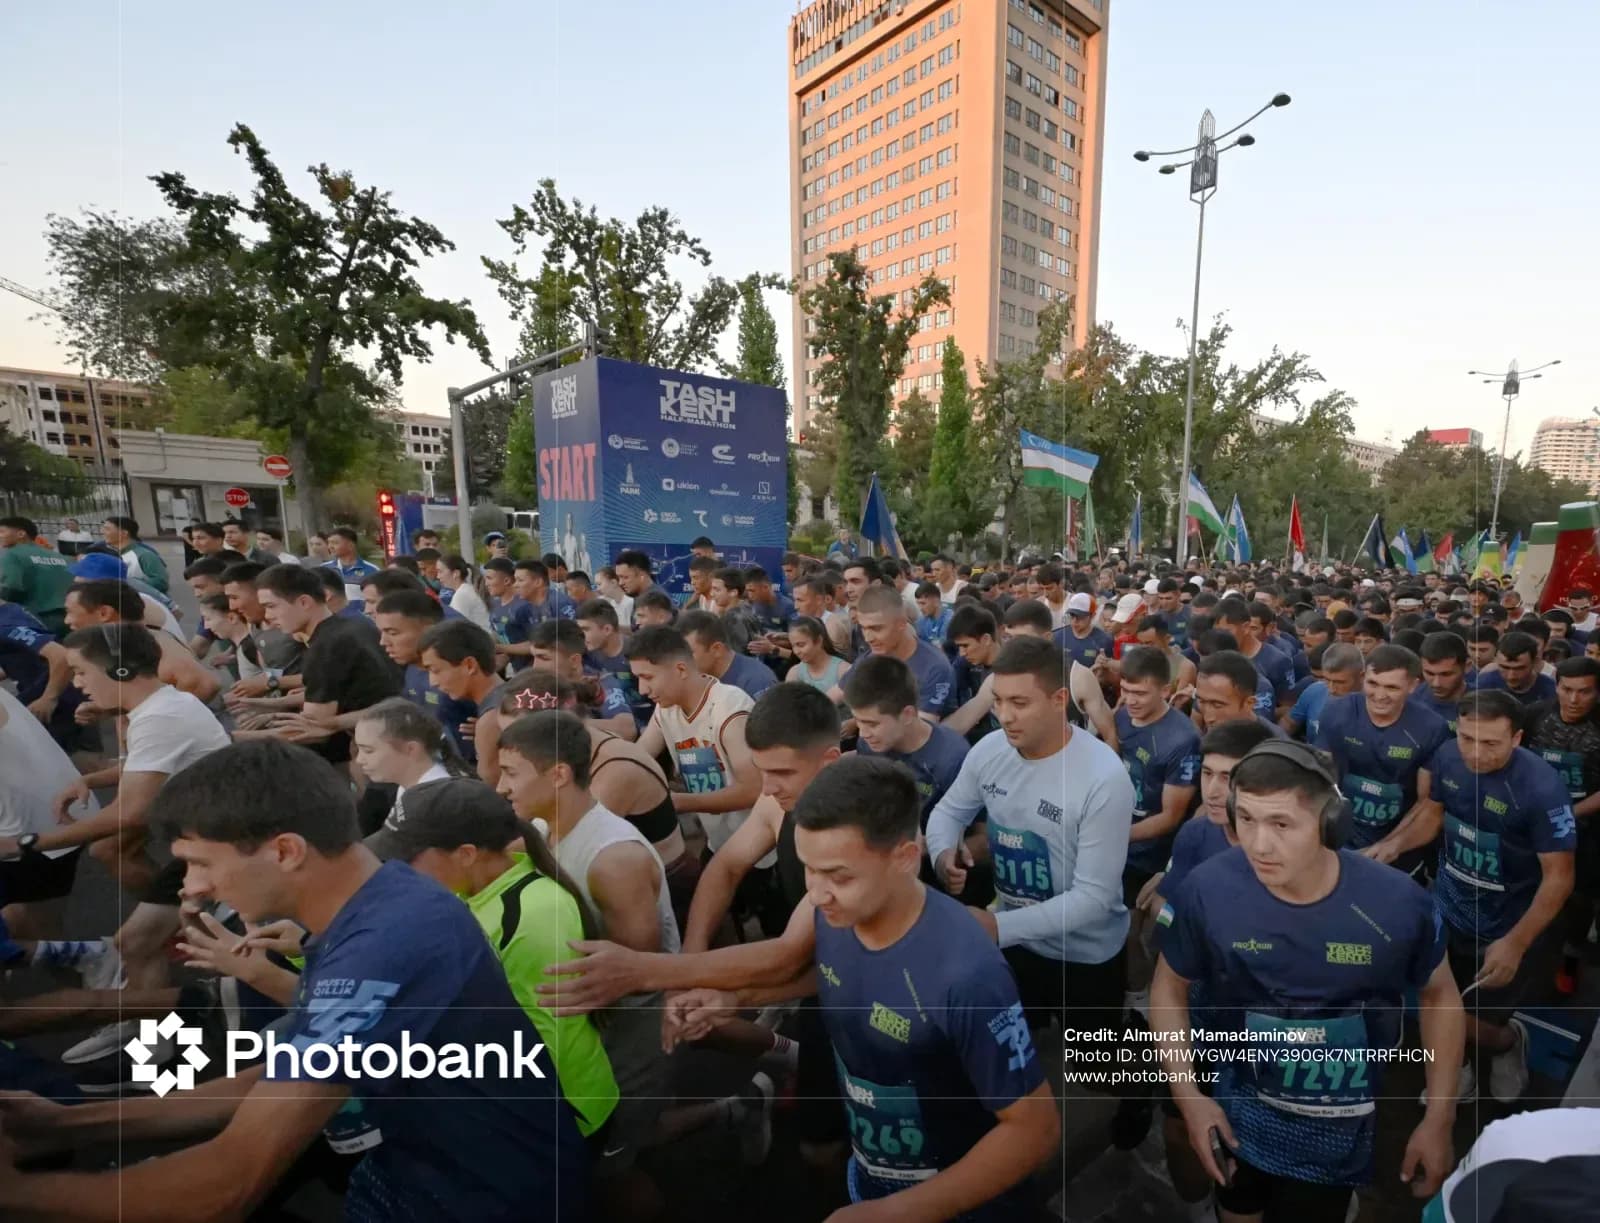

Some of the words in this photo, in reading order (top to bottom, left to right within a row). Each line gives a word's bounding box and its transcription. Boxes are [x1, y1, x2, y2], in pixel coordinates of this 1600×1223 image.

[659, 379, 736, 413] TASH
[660, 395, 731, 424] KENT
[660, 414, 737, 430] HALF-MARATHON
[539, 442, 596, 502] START
[226, 494, 248, 502] STOP
[620, 487, 640, 496] PARK
[1353, 796, 1400, 821] 7069
[994, 853, 1050, 892] 5115
[1256, 942, 1273, 950] RUN
[1277, 1055, 1369, 1090] 7292
